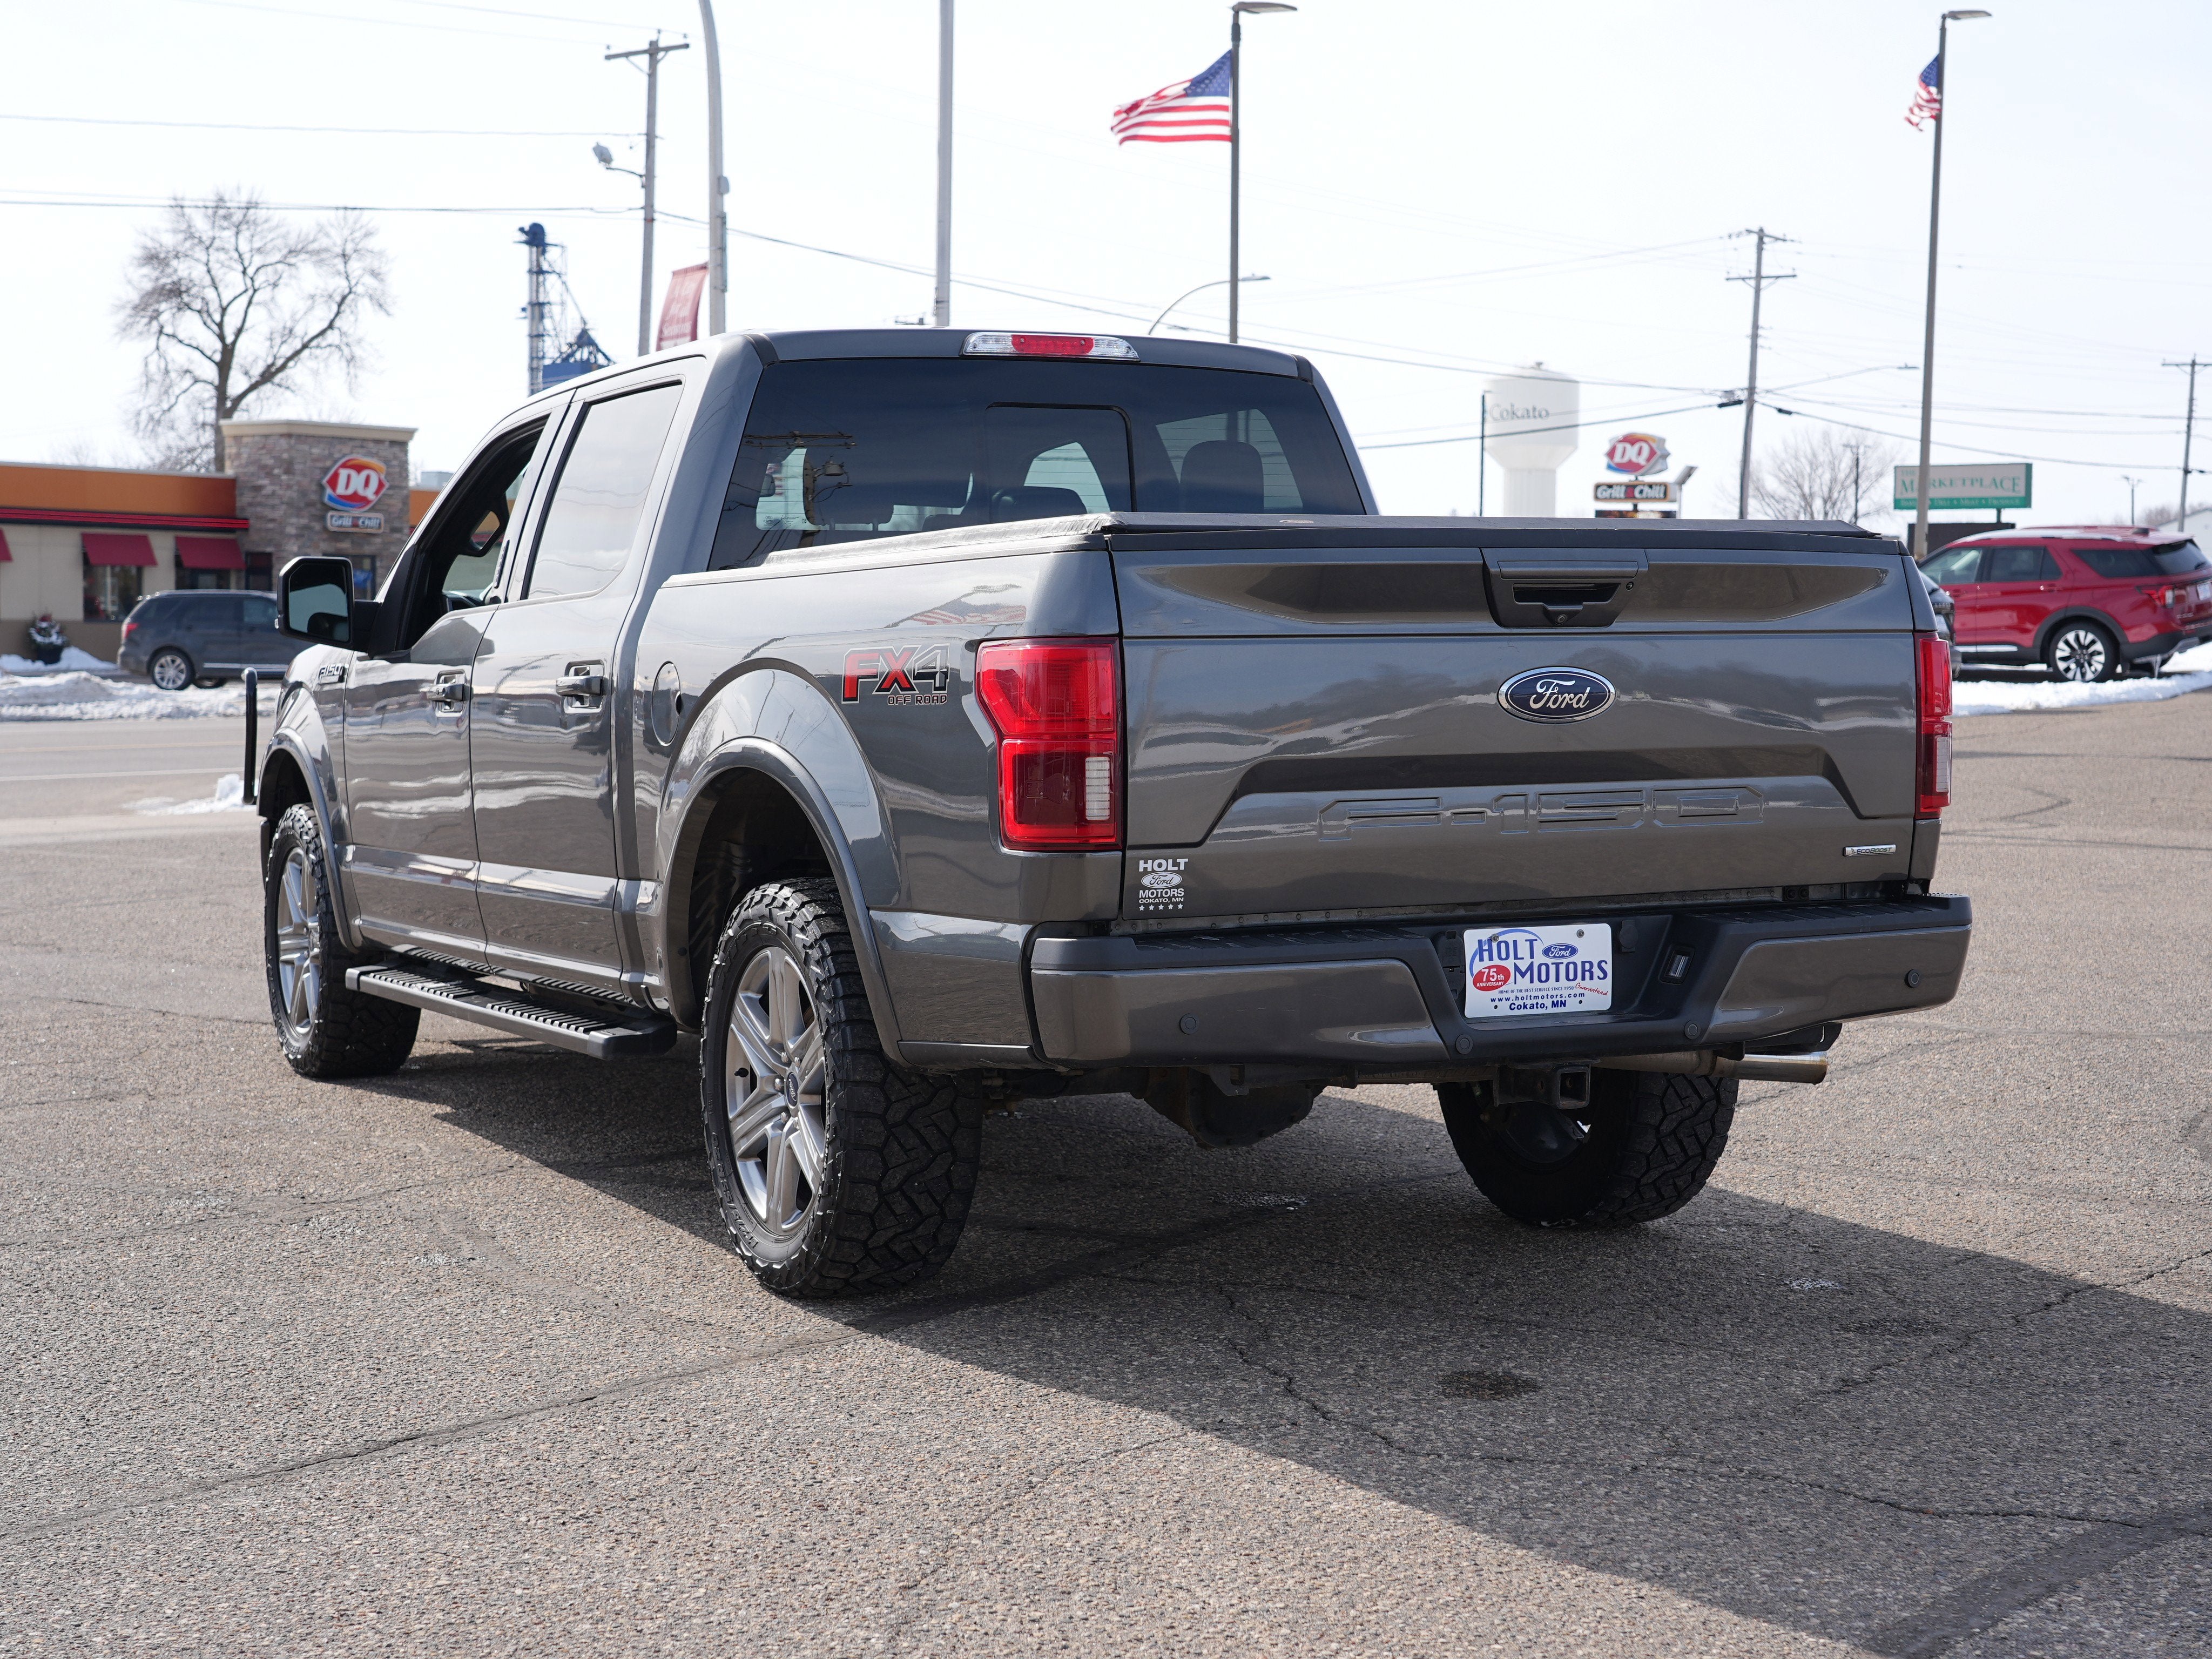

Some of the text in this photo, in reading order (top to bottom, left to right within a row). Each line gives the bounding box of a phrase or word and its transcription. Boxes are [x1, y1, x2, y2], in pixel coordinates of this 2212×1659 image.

[1490, 402, 1549, 421] Cokato
[1613, 441, 1650, 466] DQ
[335, 468, 379, 501] DQ
[1596, 485, 1625, 498] Grill
[1635, 484, 1666, 498] Chill
[1900, 475, 2021, 495] MRKETPLACE
[841, 643, 950, 704] FX4
[888, 694, 948, 706] OFF ROAD
[1529, 679, 1591, 709] Ford
[1318, 786, 1764, 841] F-150
[1138, 858, 1189, 872] HOLT
[1149, 874, 1174, 885] Ford
[1139, 888, 1184, 898] MOTORS
[1478, 939, 1538, 962] HOLT
[1548, 946, 1572, 957] Ford
[1481, 968, 1505, 982] 75th
[1514, 960, 1608, 985] MOTORS
[1575, 982, 1609, 996] Guaranteed
[1490, 993, 1585, 1003] www.holtmotors.com
[1509, 1000, 1567, 1011] Cokato, MN
